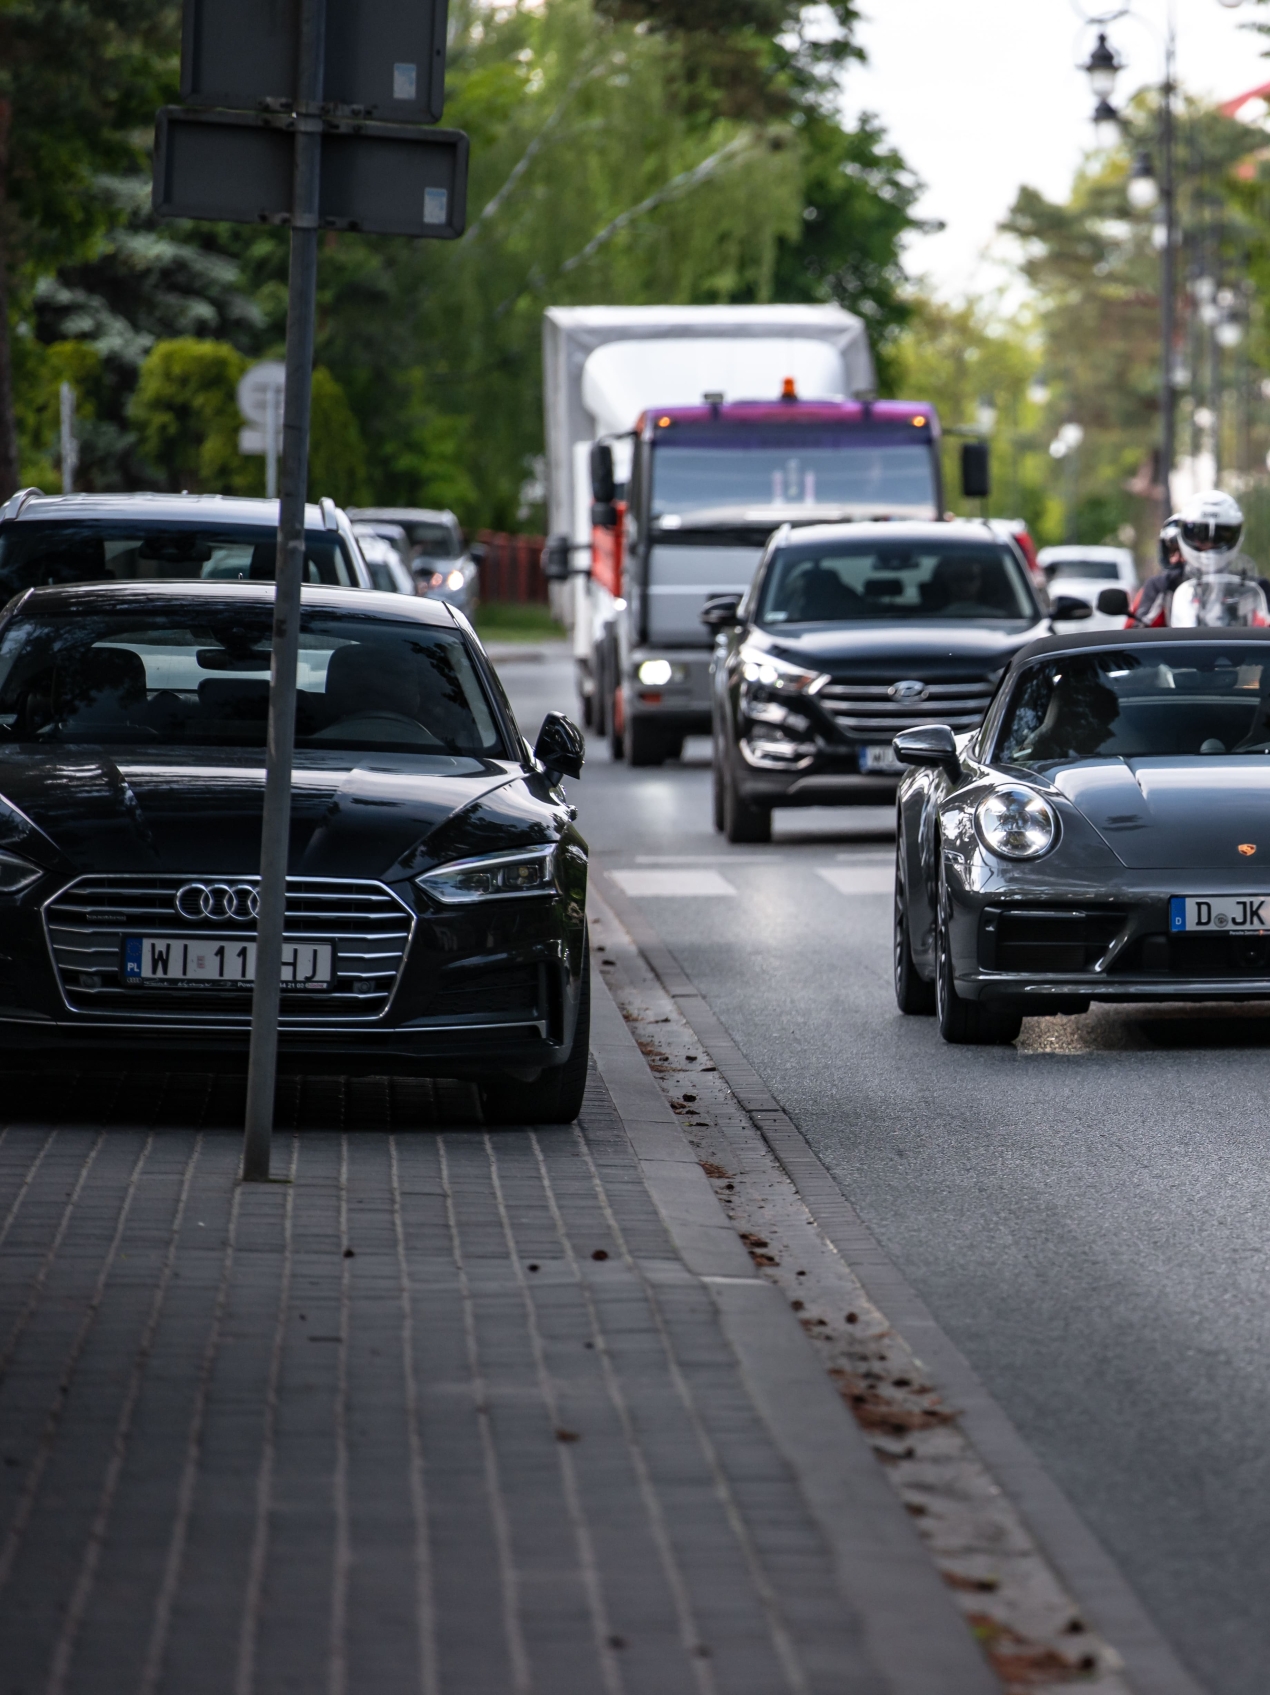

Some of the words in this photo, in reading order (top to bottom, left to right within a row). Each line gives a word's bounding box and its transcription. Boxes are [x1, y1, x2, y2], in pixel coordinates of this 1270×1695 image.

[1175, 917, 1182, 925] D
[1195, 902, 1212, 926] D
[127, 962, 140, 972] PL
[151, 942, 189, 977] WI
[213, 945, 318, 981] 11HJ
